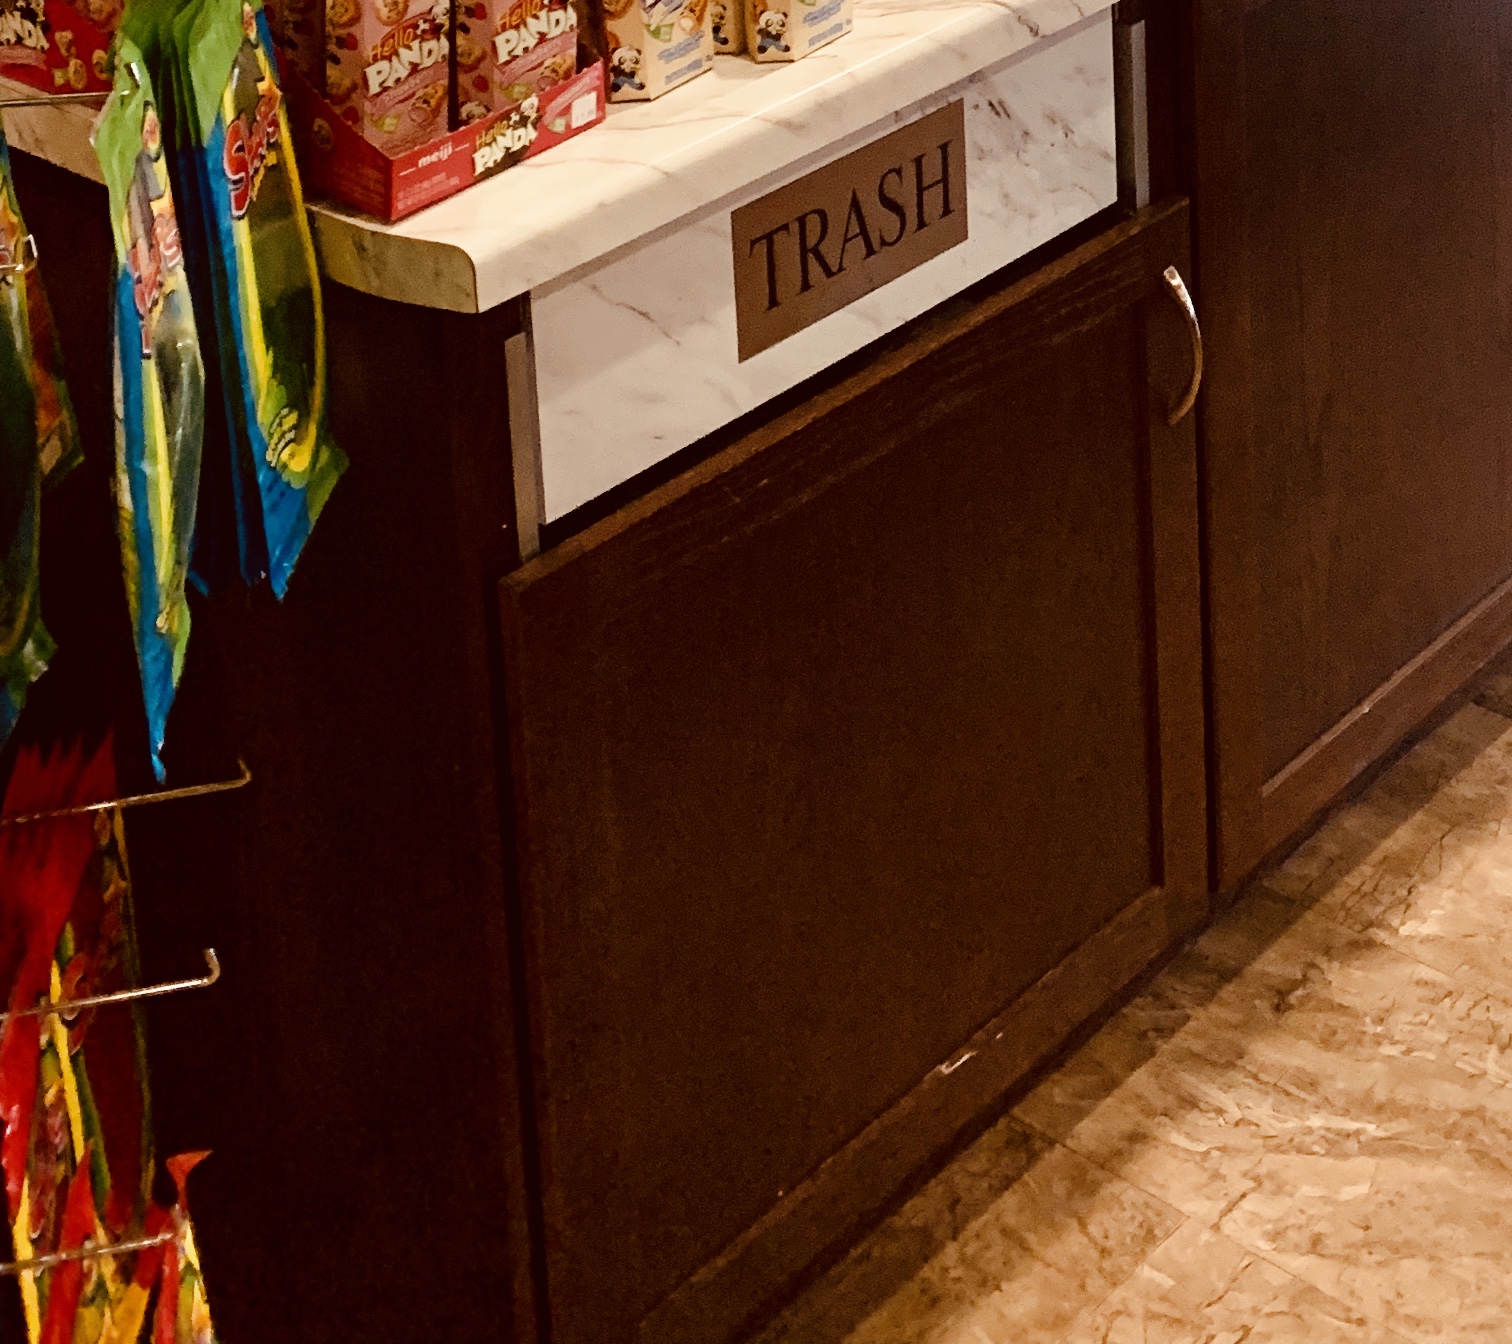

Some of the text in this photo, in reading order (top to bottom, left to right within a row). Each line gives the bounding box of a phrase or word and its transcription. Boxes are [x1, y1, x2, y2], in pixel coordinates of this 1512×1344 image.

[0, 9, 49, 51] ANDA
[370, 27, 414, 61] Hello
[495, 4, 578, 65] PANDA
[364, 35, 450, 96] PANDA
[418, 143, 453, 167] meiji
[472, 125, 538, 175] PANDA
[476, 119, 508, 149] Hello
[749, 139, 954, 311] TRASH
